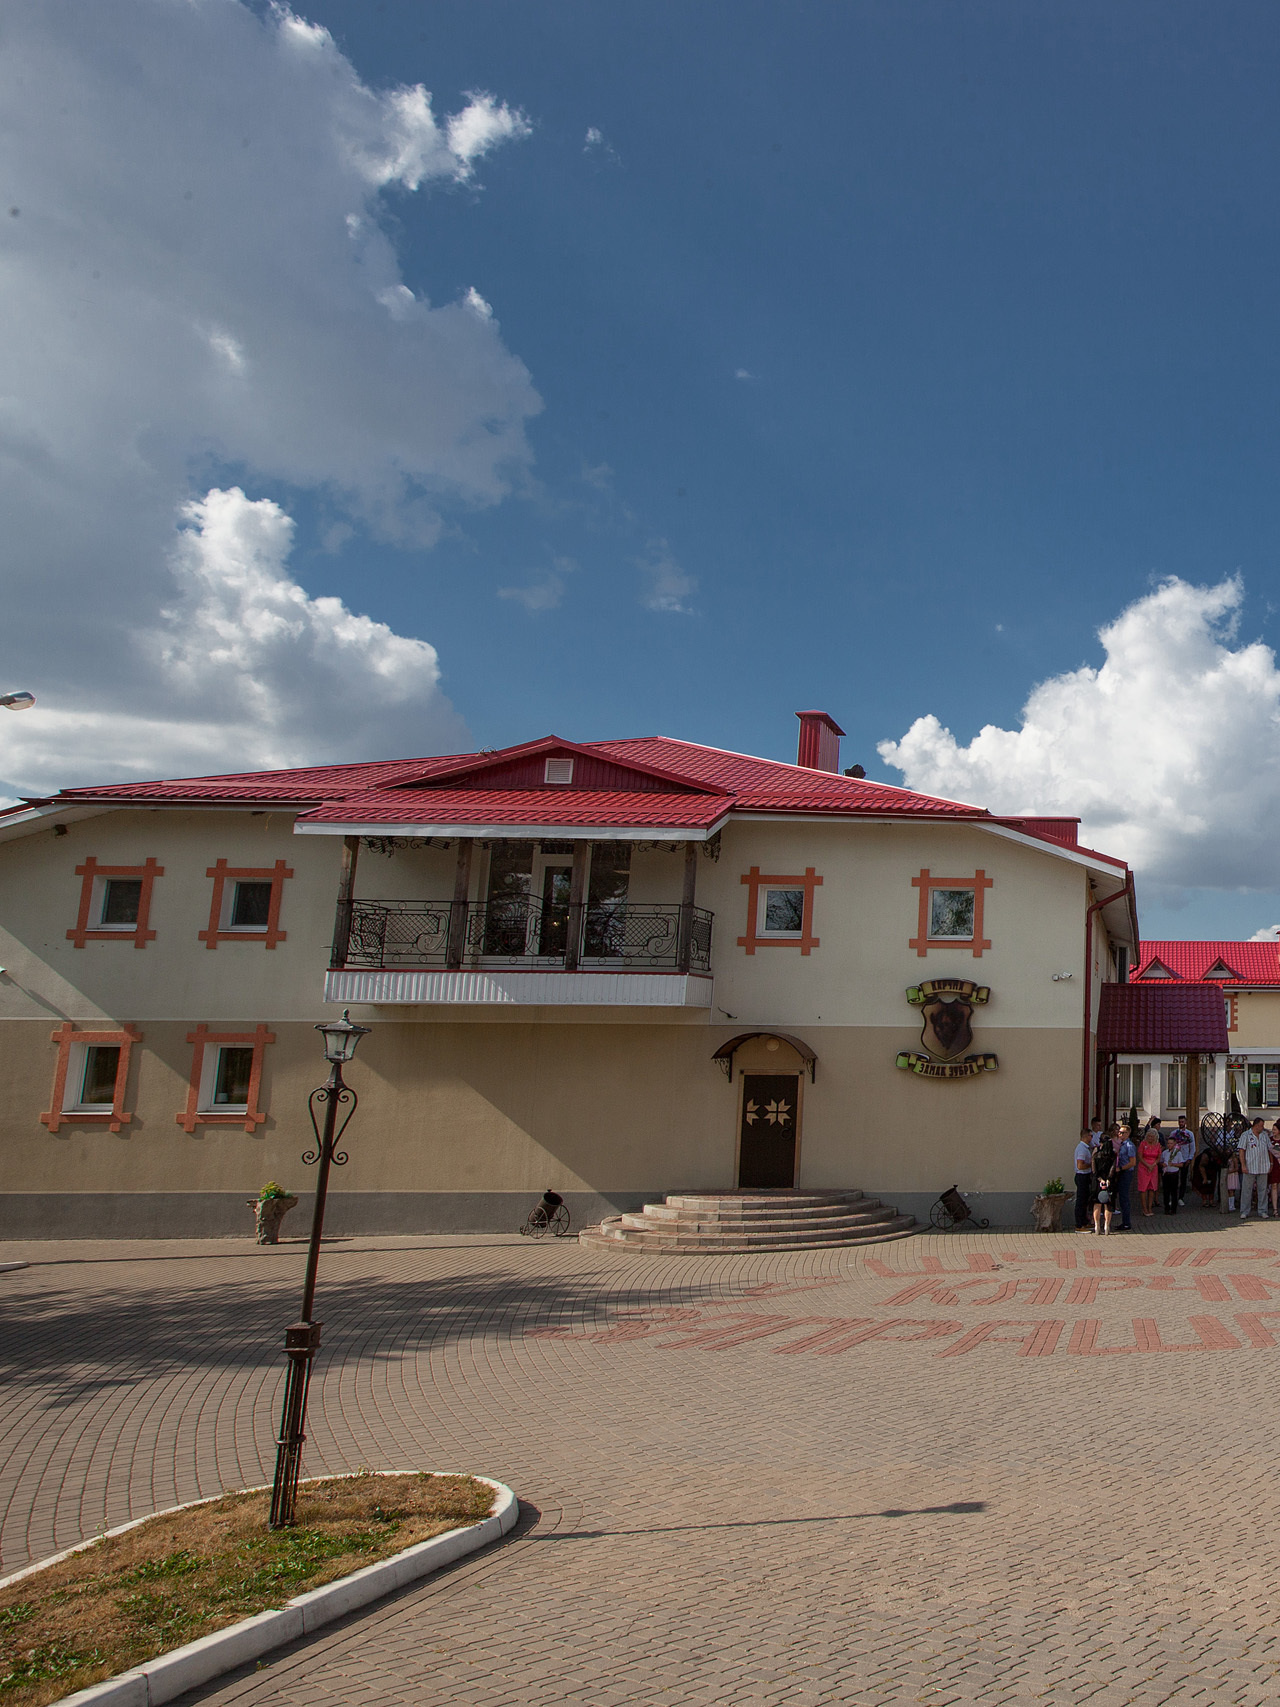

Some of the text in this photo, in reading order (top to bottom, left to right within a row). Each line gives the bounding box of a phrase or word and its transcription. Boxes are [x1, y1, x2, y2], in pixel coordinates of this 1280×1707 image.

[1226, 1055, 1248, 1064] БАР
[918, 1063, 975, 1077] ЗАМАК ЗУБРА
